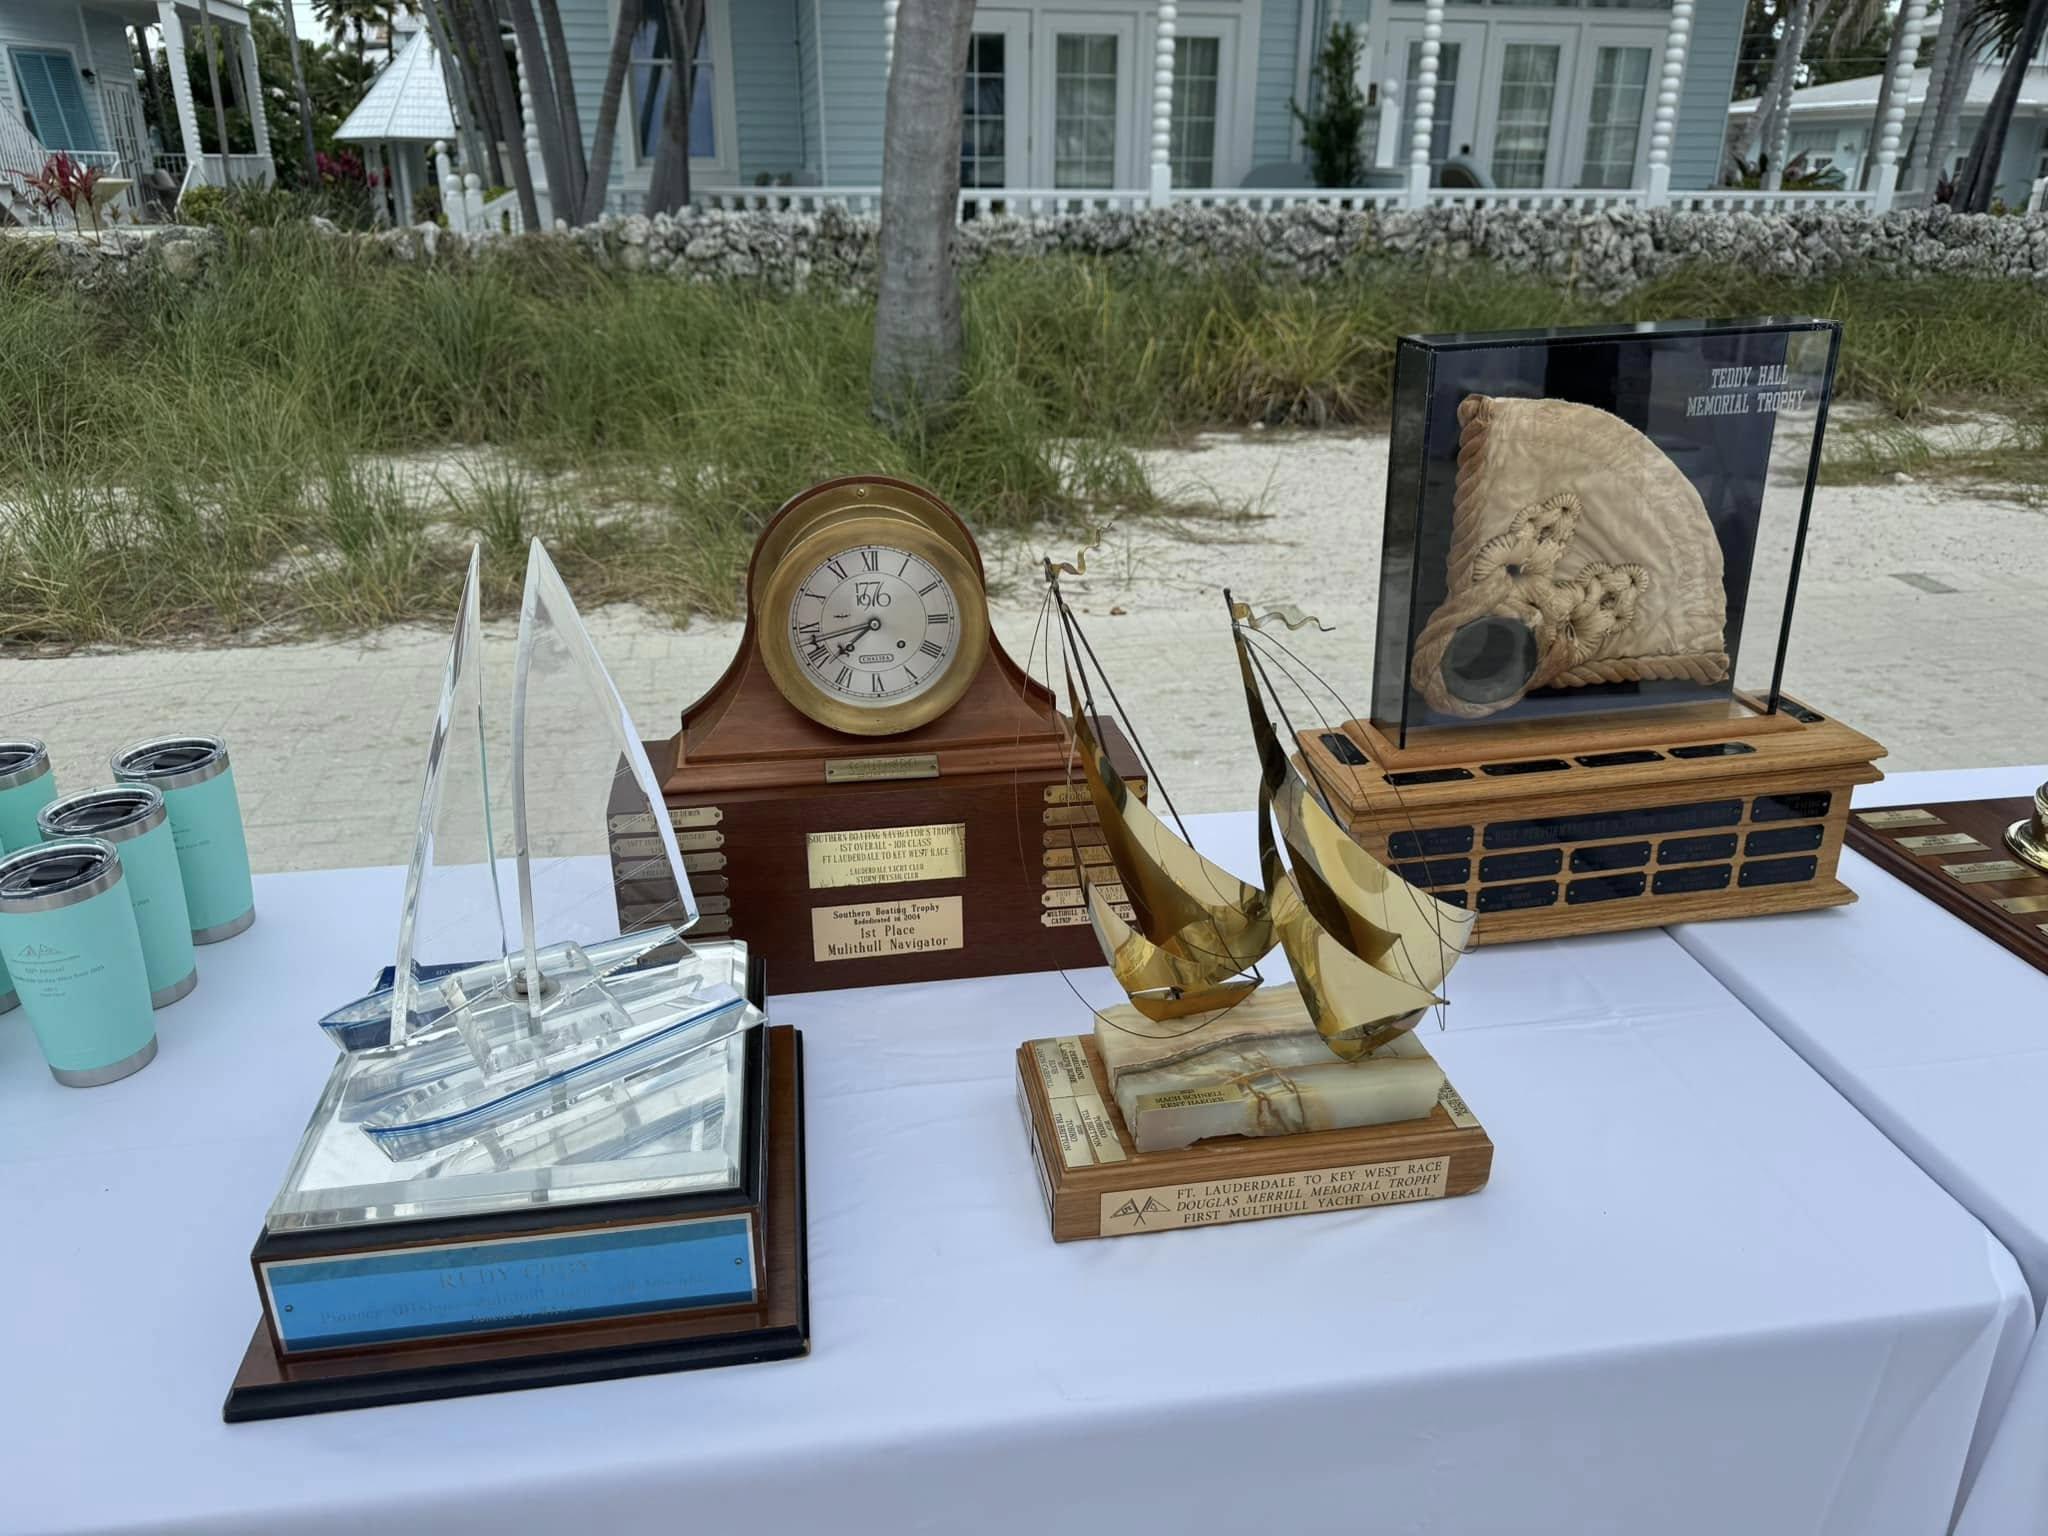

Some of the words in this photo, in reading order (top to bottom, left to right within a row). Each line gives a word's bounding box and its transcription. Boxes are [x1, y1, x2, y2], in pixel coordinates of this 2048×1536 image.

[1711, 367, 1752, 389] TEDDY
[1757, 364, 1788, 386] HALL
[1686, 393, 1749, 417] MEMORIAL
[1757, 389, 1806, 413] TROPHY
[808, 833, 847, 843] SOUTHERN
[854, 840, 886, 852] OVERALL
[907, 838, 932, 848] CLASS
[833, 850, 880, 864] LAUDERDALE
[908, 848, 929, 858] WEST
[833, 909, 871, 920] Southern
[875, 905, 907, 916] Boating
[911, 902, 940, 914] Trophy
[860, 927, 877, 939] 1st
[884, 924, 915, 937] Place
[828, 939, 882, 957] Mulithull
[890, 937, 949, 951] Navigator
[1176, 1188, 1196, 1200] FT.
[1205, 1177, 1296, 1196] LAUDERDALE
[1304, 1174, 1322, 1185] TO
[1330, 1170, 1357, 1183] KEY
[1364, 1166, 1401, 1179] WEST
[1408, 1161, 1443, 1174] RACE
[1176, 1195, 1239, 1212] DOUGLAS
[1245, 1188, 1303, 1205] MERRILL
[1310, 1181, 1381, 1198] MEMORIAL
[1388, 1173, 1441, 1188] TROPHY
[1183, 1210, 1221, 1224] FIRST
[1228, 1200, 1310, 1218] MULTIHULL
[1317, 1194, 1364, 1209] YACHT
